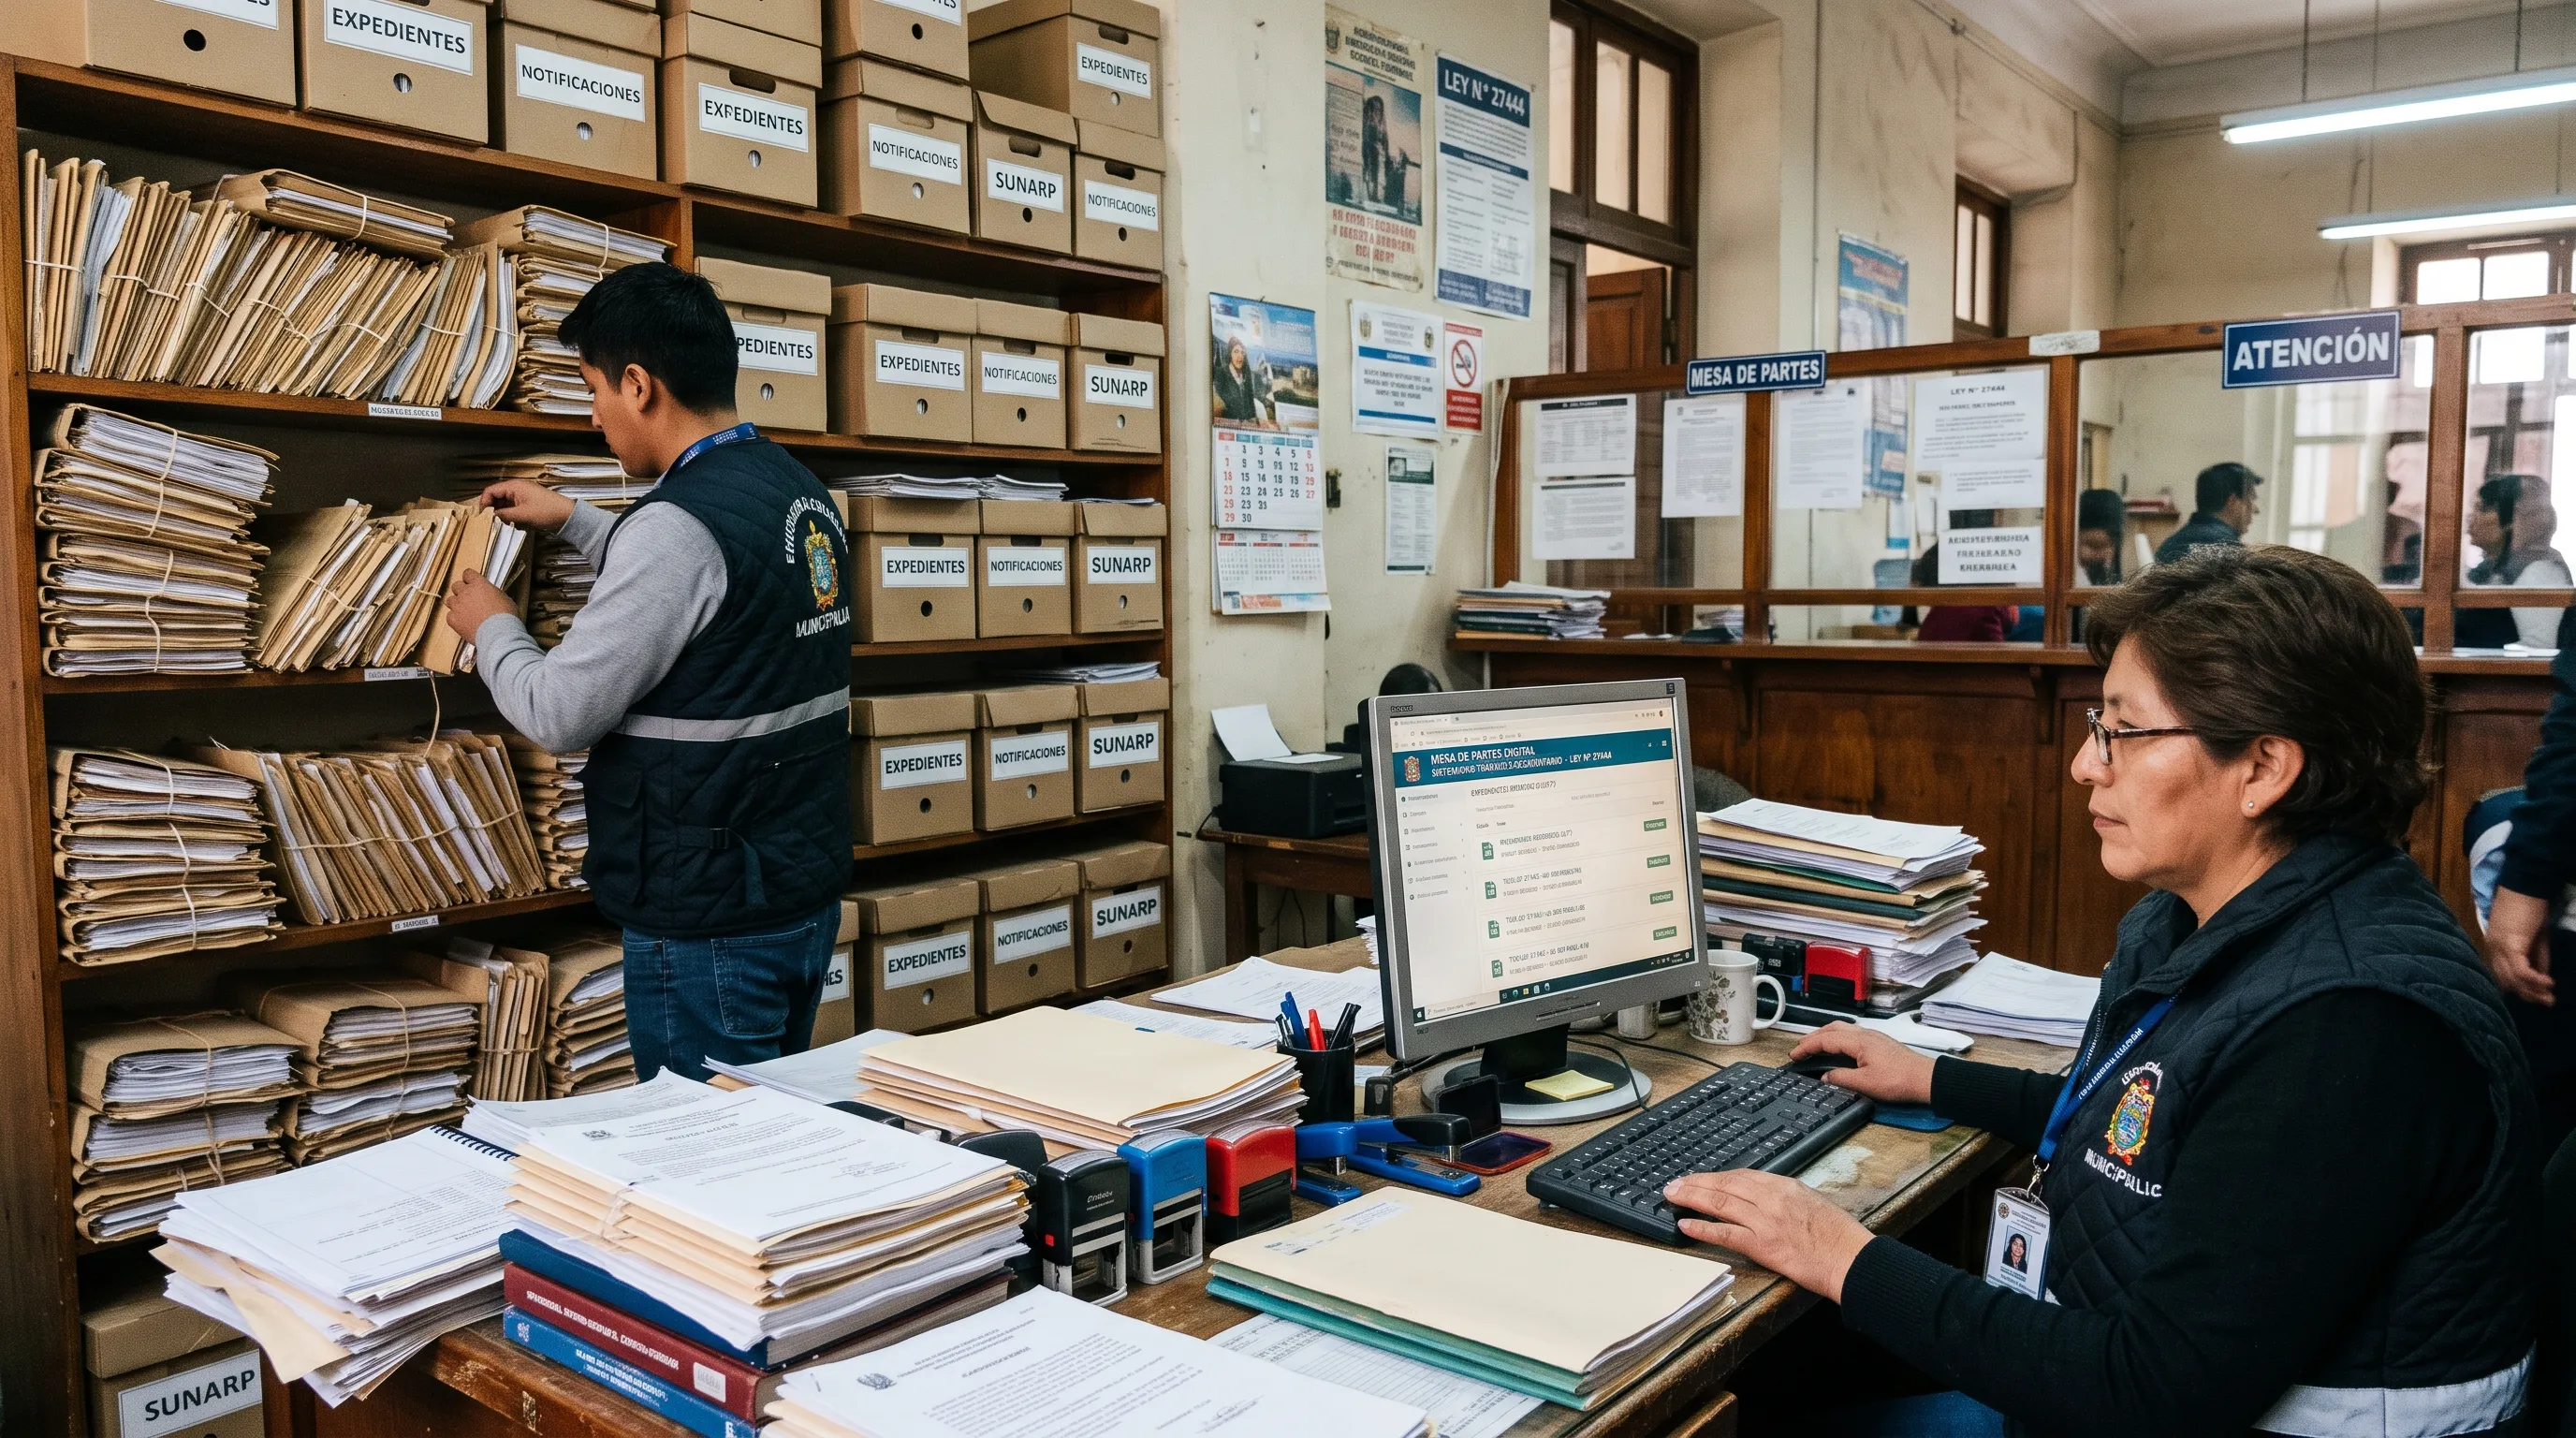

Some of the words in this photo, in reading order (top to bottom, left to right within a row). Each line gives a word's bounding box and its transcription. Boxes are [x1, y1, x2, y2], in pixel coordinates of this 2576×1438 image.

[332, 7, 465, 54] EXPEDIENTES
[1081, 56, 1148, 85] EXPEDIENTES
[521, 64, 641, 104] NOTIFICACIONES
[1444, 68, 1470, 95] LEY
[1491, 86, 1525, 116] 27444
[704, 99, 803, 136] EXPEDIENTES
[872, 139, 959, 170] NOTIFICACIONES
[995, 171, 1057, 199] SUNARP
[1088, 193, 1157, 218] NOTIFICACIONES
[738, 336, 813, 360] PEDIENTES
[2233, 326, 2390, 372] ATENCIÓN
[881, 354, 960, 377] EXPEDIENTES
[984, 366, 1058, 386] NOTIFICACIONES
[1691, 366, 1733, 388] MESA
[1736, 364, 1757, 384] DE
[1761, 359, 1820, 383] PARTES
[1090, 375, 1149, 398] SUNARP
[1275, 447, 1281, 457] 4
[1242, 513, 1251, 523] 30
[886, 559, 966, 576] EXPEDIENTES
[990, 560, 1063, 573] NOTIFICACIONES
[1091, 556, 1152, 575] SUNARP
[995, 745, 1066, 765] NOTIFICACIONES
[1092, 731, 1155, 755] SUNARP
[885, 753, 963, 775] EXPEDIENTES
[1430, 752, 1456, 766] MESA
[1457, 751, 1469, 762] DE
[1471, 748, 1502, 761] PARTES
[1096, 898, 1158, 927] SUNARP
[997, 919, 1069, 947] NOTIFICACIONES
[887, 944, 967, 975] EXPEDIENTES
[144, 1369, 256, 1422] SUNARP
